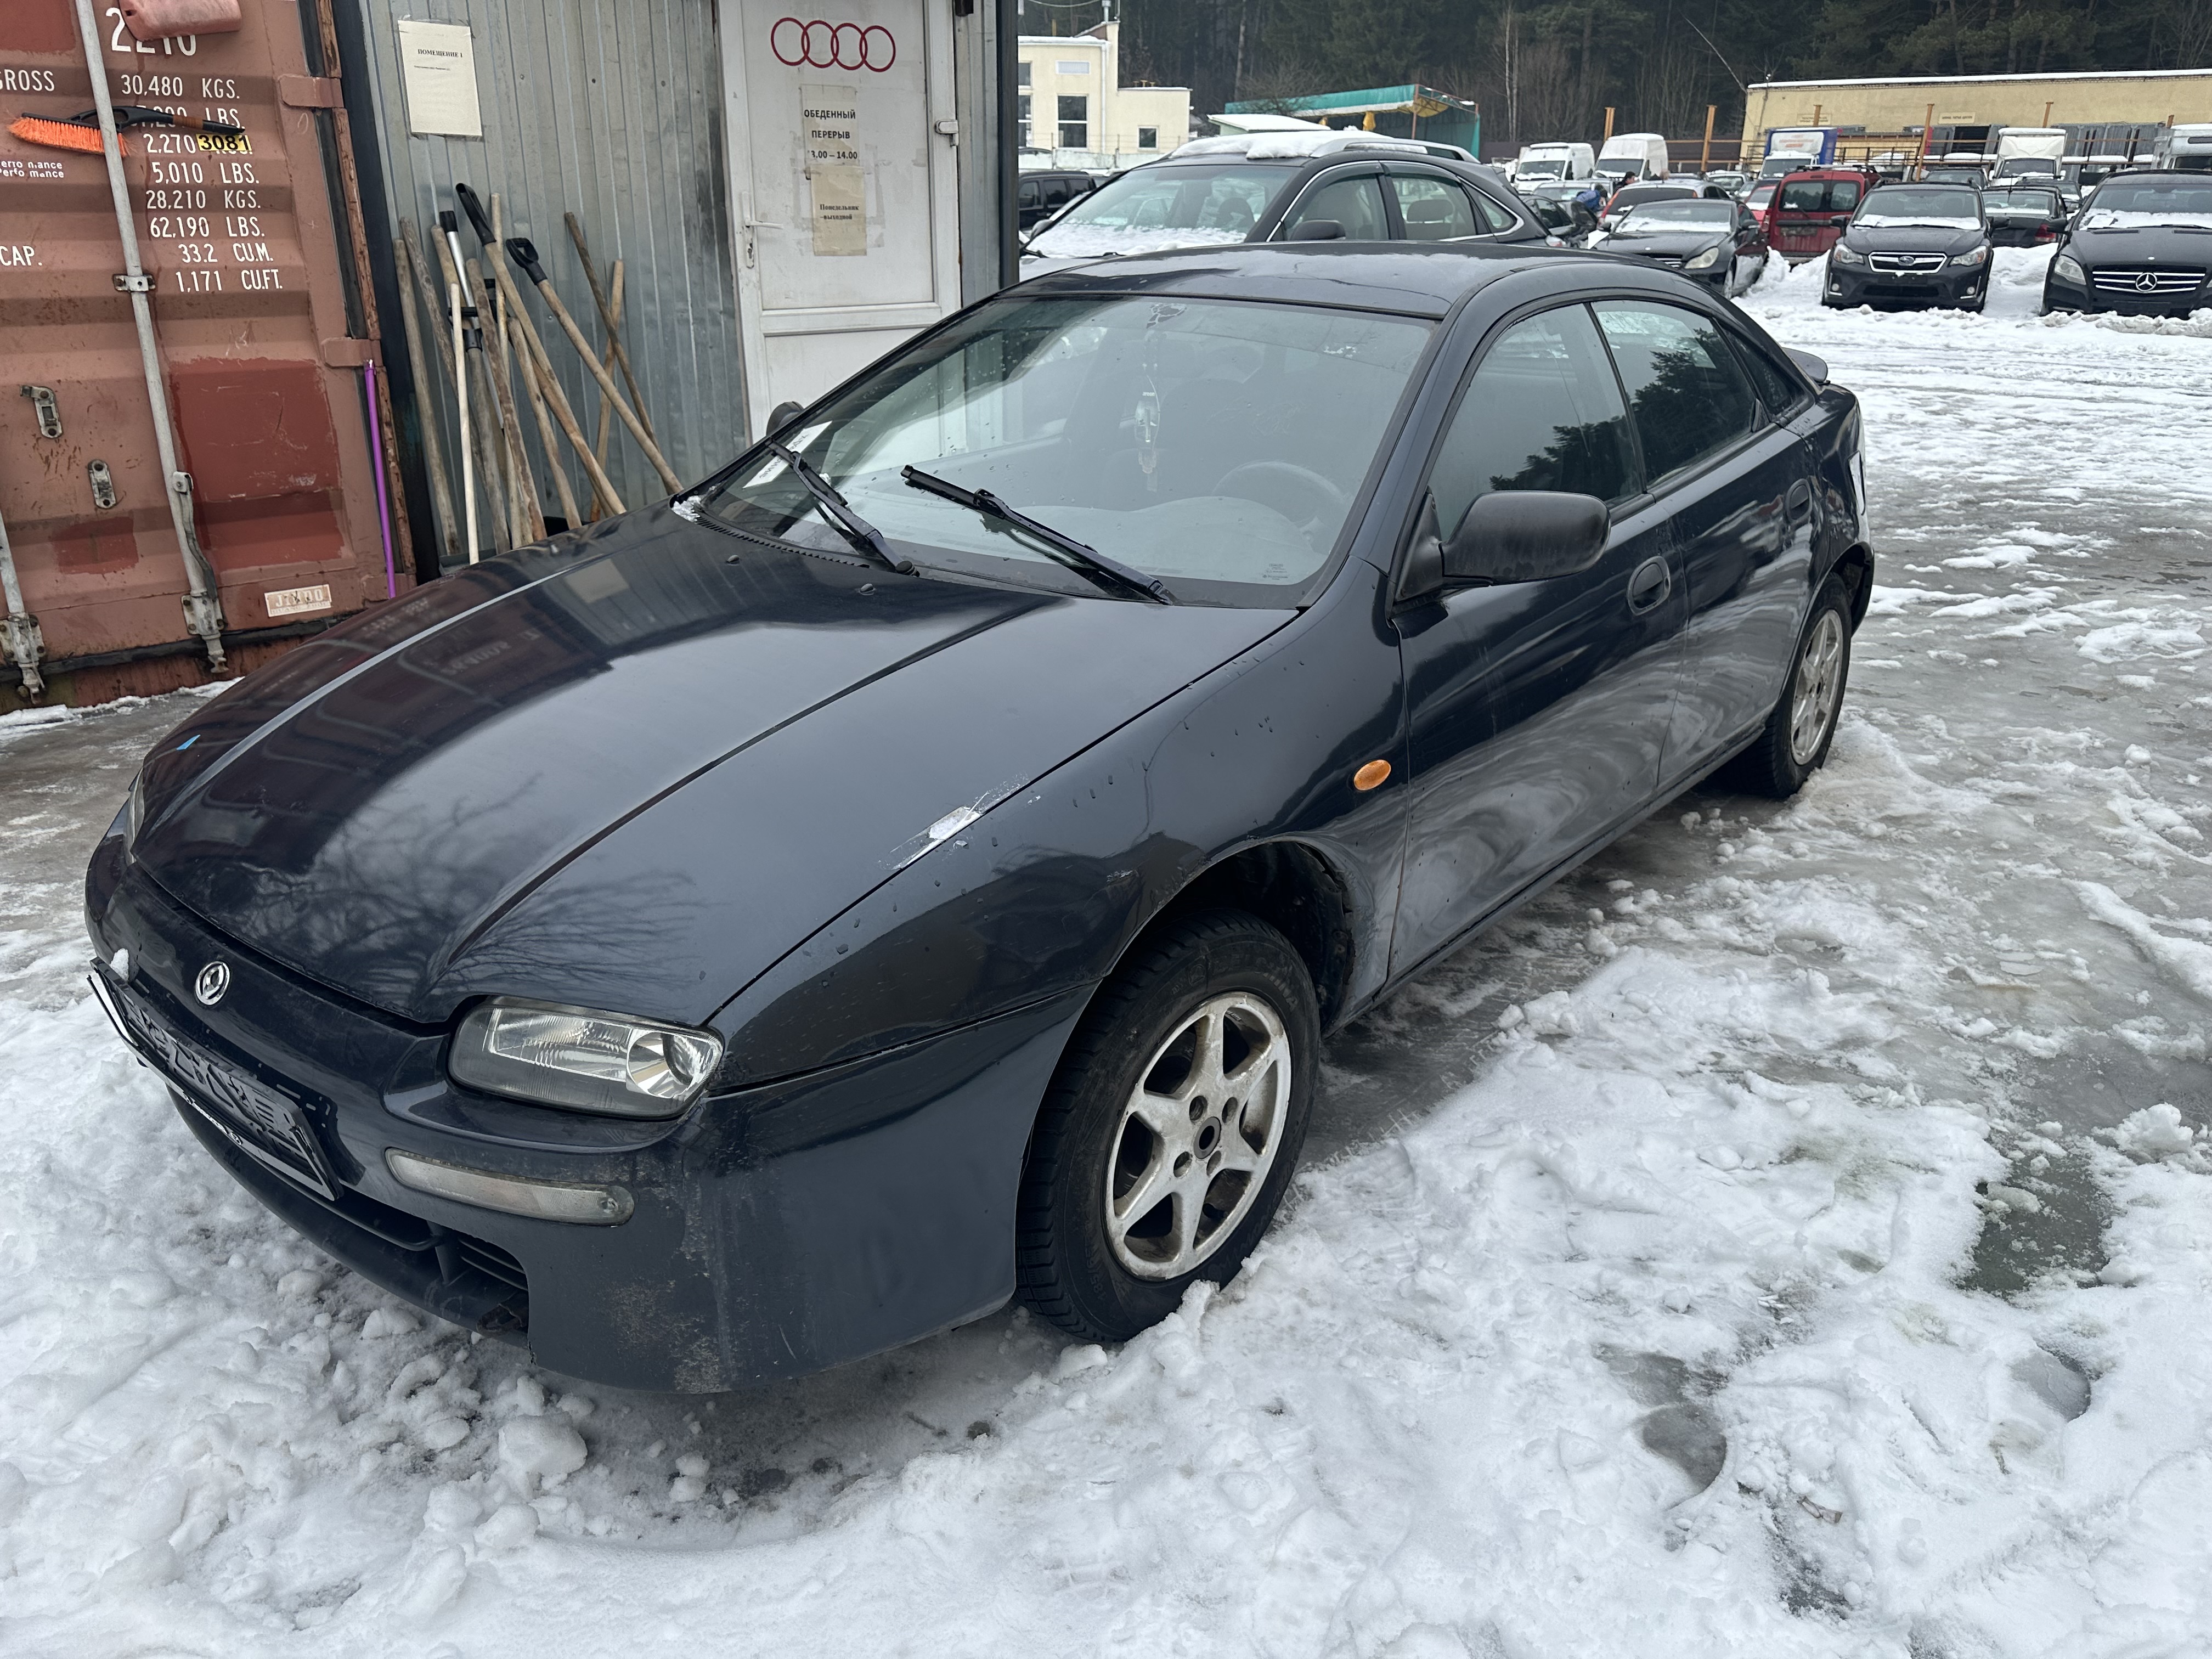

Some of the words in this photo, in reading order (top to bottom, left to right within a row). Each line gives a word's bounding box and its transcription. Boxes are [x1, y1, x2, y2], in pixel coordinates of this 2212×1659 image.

[0, 69, 55, 91] ROSS
[121, 74, 183, 97] 30,480
[202, 78, 240, 99] KGS.
[804, 109, 856, 120] ОБЕДЕННЫЙ
[198, 134, 249, 150] 3081
[811, 130, 850, 139] ПЕРЕРЫВ
[837, 151, 857, 159] 14.00
[151, 162, 203, 184] 5,010
[219, 162, 259, 184] LBS.
[146, 190, 206, 209] 28,210
[224, 190, 261, 208] KGS.
[150, 217, 210, 238] 62,190
[226, 216, 265, 237] LBS.
[0, 246, 42, 266] CAP.
[178, 243, 218, 263] 33.2
[233, 242, 274, 262] CU.M.
[176, 270, 222, 292] 1,171
[241, 269, 283, 290] CU.FT.
